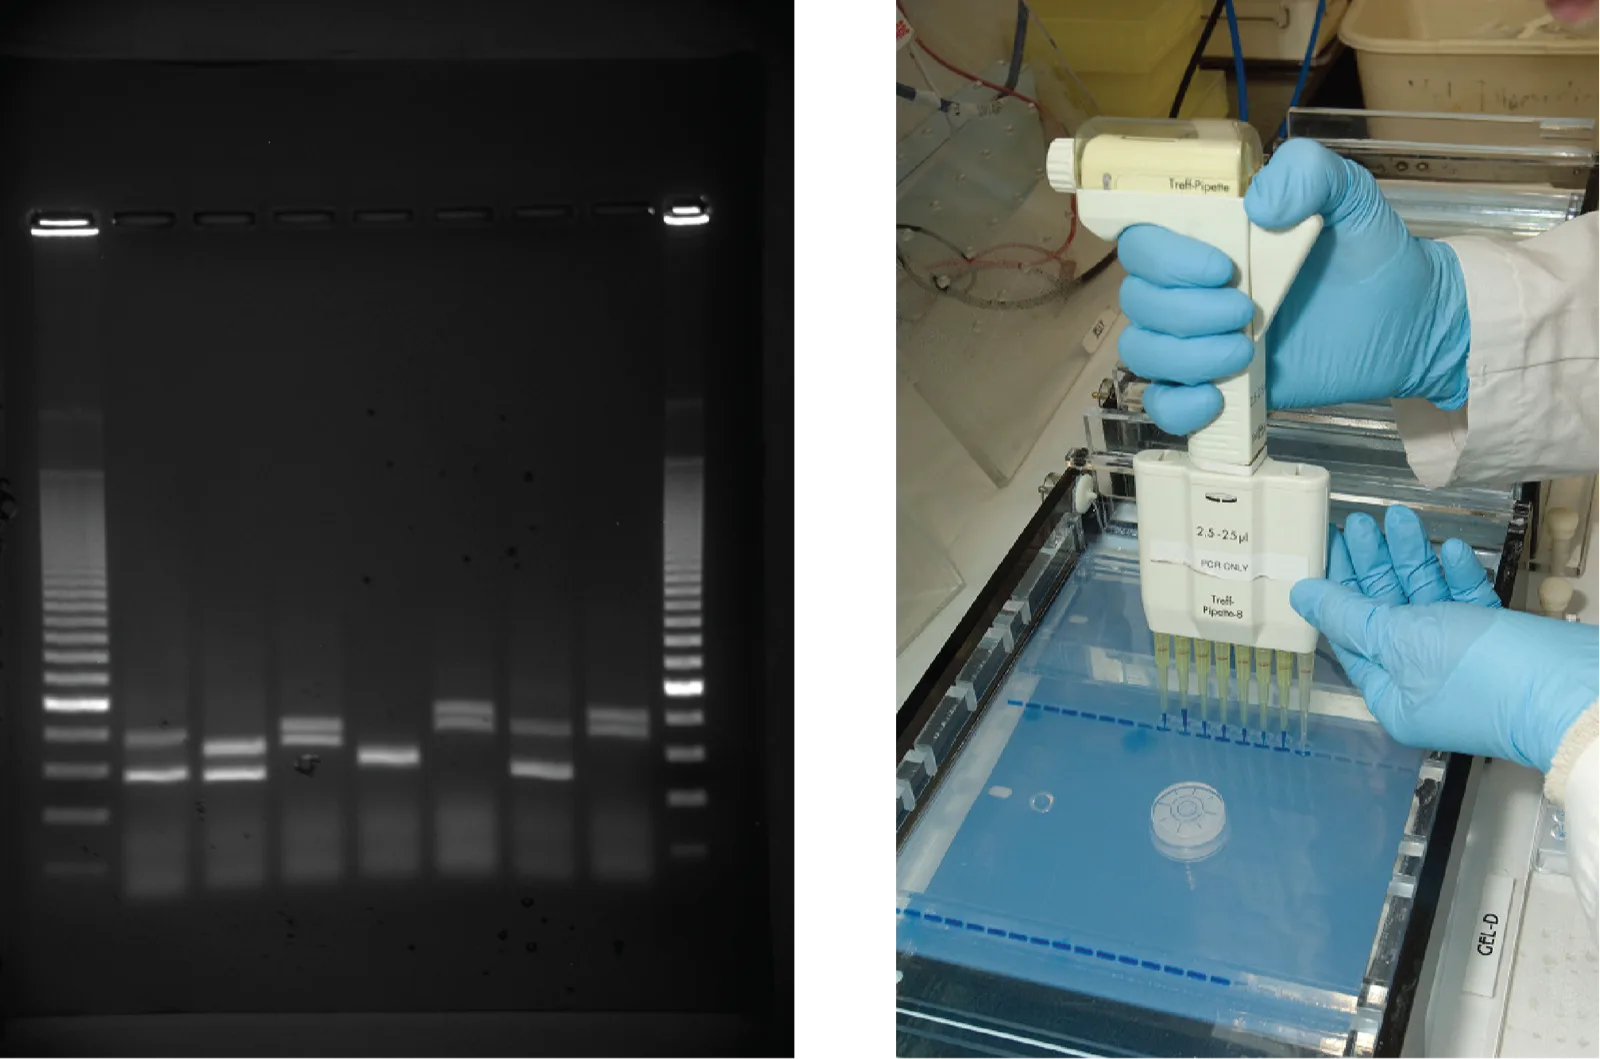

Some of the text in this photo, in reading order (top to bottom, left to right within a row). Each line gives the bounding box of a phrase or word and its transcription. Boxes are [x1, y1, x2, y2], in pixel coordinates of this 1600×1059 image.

[1169, 177, 1229, 194] Treff-Pipette
[1200, 559, 1249, 572] PCR ONLY
[1211, 594, 1235, 606] Treff-
[1203, 605, 1243, 619] Pipette-8
[1477, 913, 1499, 956] GEL-D
